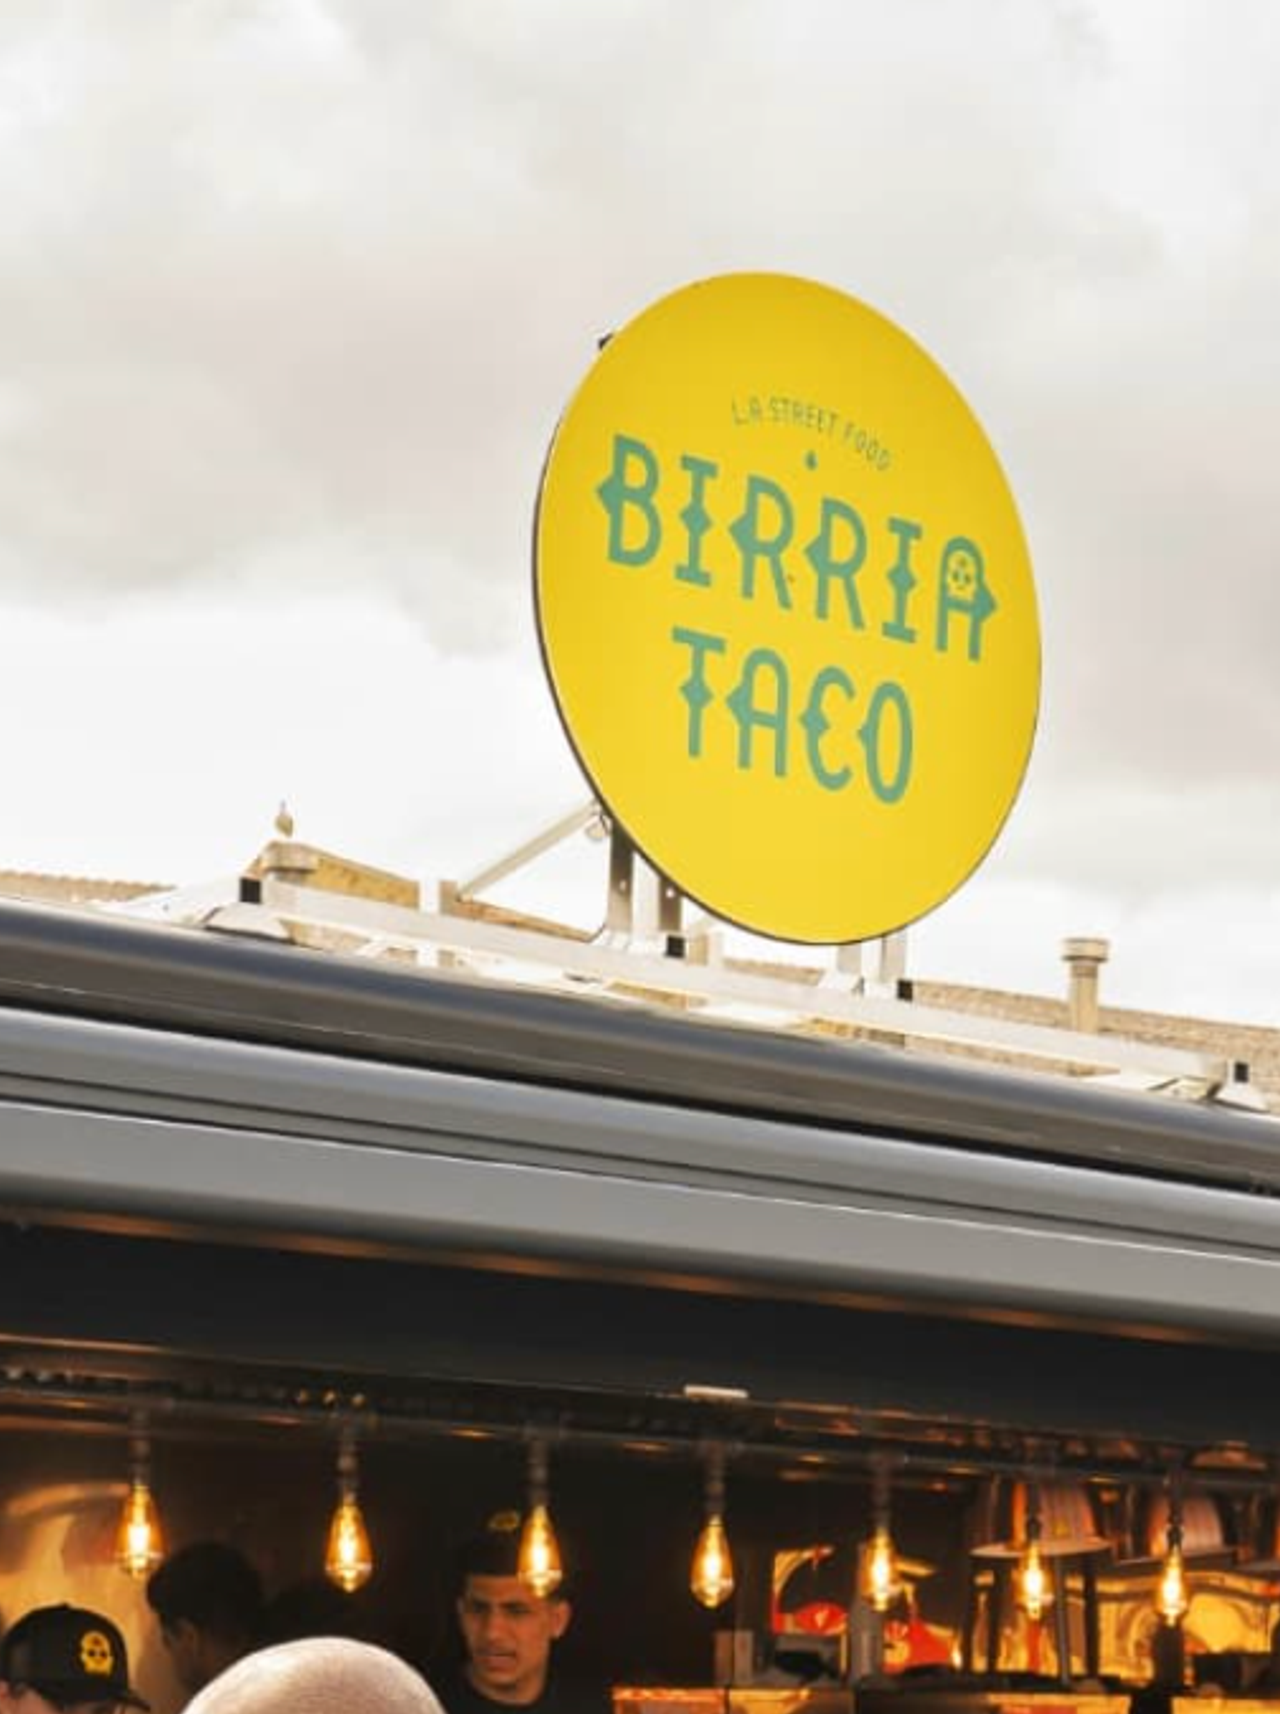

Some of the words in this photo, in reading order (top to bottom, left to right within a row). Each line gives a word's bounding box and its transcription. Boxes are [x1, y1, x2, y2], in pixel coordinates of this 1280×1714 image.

[770, 395, 838, 437] STREET
[844, 421, 891, 471] FOOD
[596, 433, 998, 661] BIRRIA
[672, 626, 914, 804] TACO
